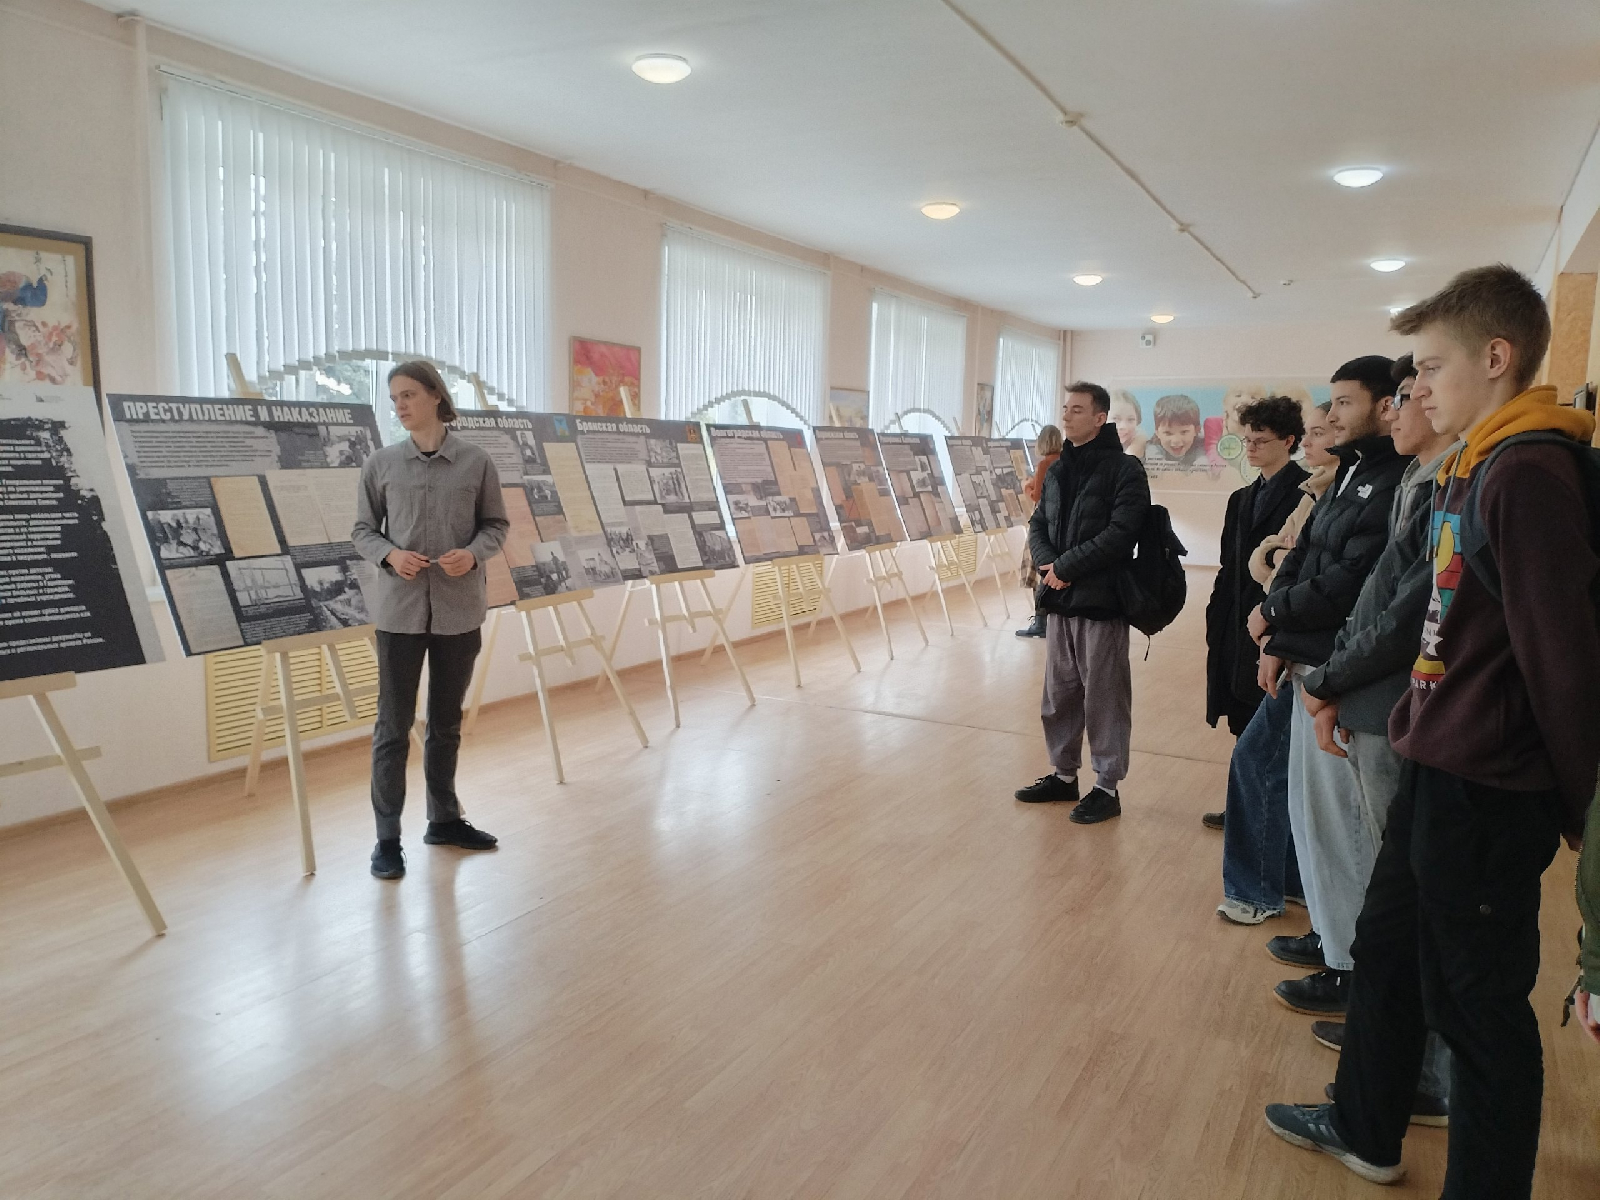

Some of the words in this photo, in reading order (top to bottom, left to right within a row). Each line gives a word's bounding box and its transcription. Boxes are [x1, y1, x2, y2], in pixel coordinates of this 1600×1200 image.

[122, 401, 256, 421] ПРЕСТУПЛЕНИЕ
[257, 405, 270, 422] И
[271, 405, 354, 424] НАКАЗАНИЕ
[497, 416, 533, 429] область
[575, 419, 617, 433] Брянская
[618, 421, 651, 434] область
